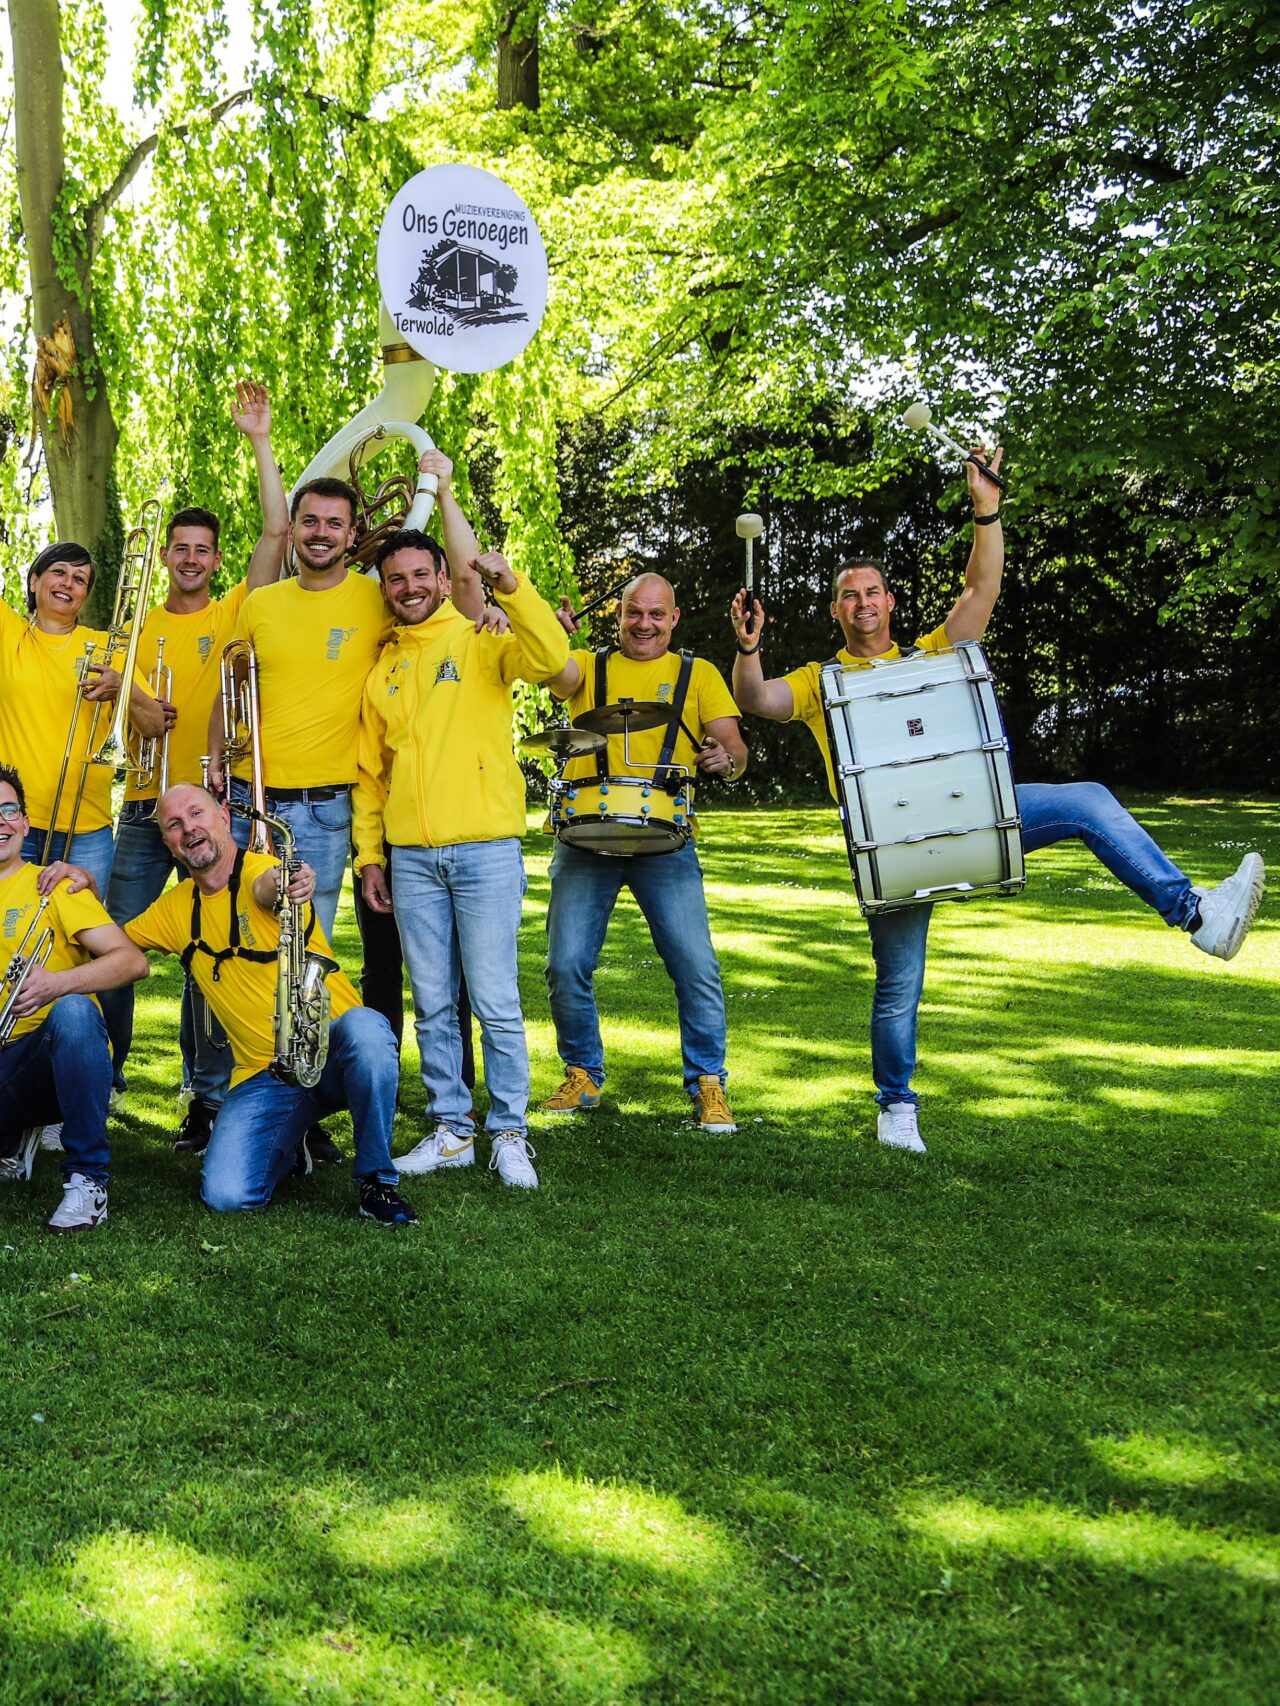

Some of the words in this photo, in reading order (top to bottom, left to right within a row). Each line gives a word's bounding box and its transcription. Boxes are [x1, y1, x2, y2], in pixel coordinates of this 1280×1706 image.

[455, 203, 526, 222] MUZIEKVERENIGING
[402, 204, 438, 235] Ons
[442, 209, 528, 250] Genoegen
[393, 312, 454, 337] Terwolde
